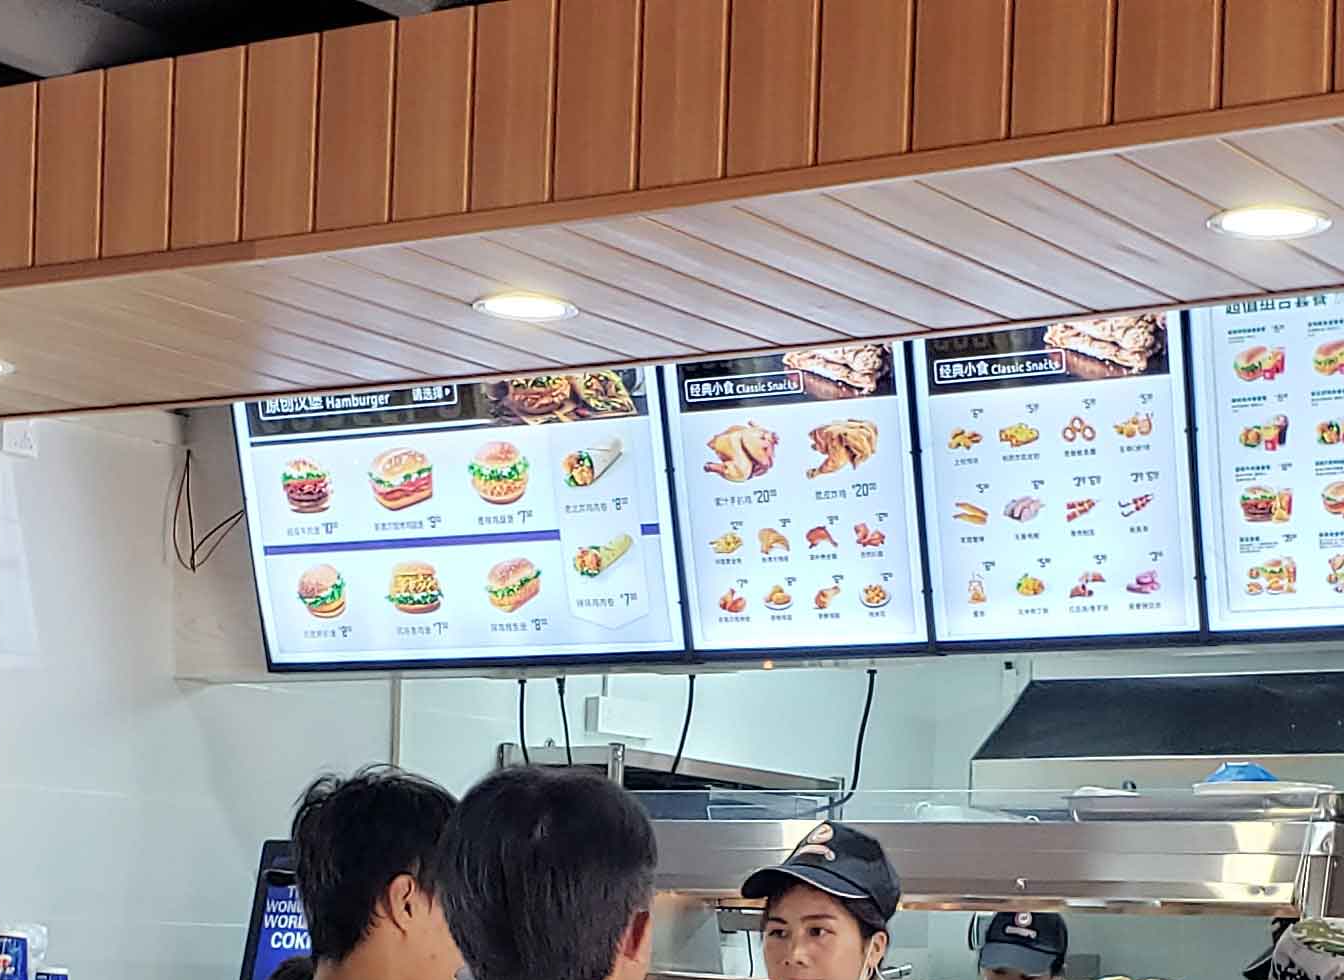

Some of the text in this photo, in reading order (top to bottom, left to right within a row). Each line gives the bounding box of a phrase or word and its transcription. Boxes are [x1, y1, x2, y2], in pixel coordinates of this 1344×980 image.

[939, 358, 1060, 379] 经典小食 Classic Snacks
[689, 379, 799, 397] 经典小食 Classic Snacks
[325, 393, 391, 410] Hamburger
[264, 913, 307, 929] WORL
